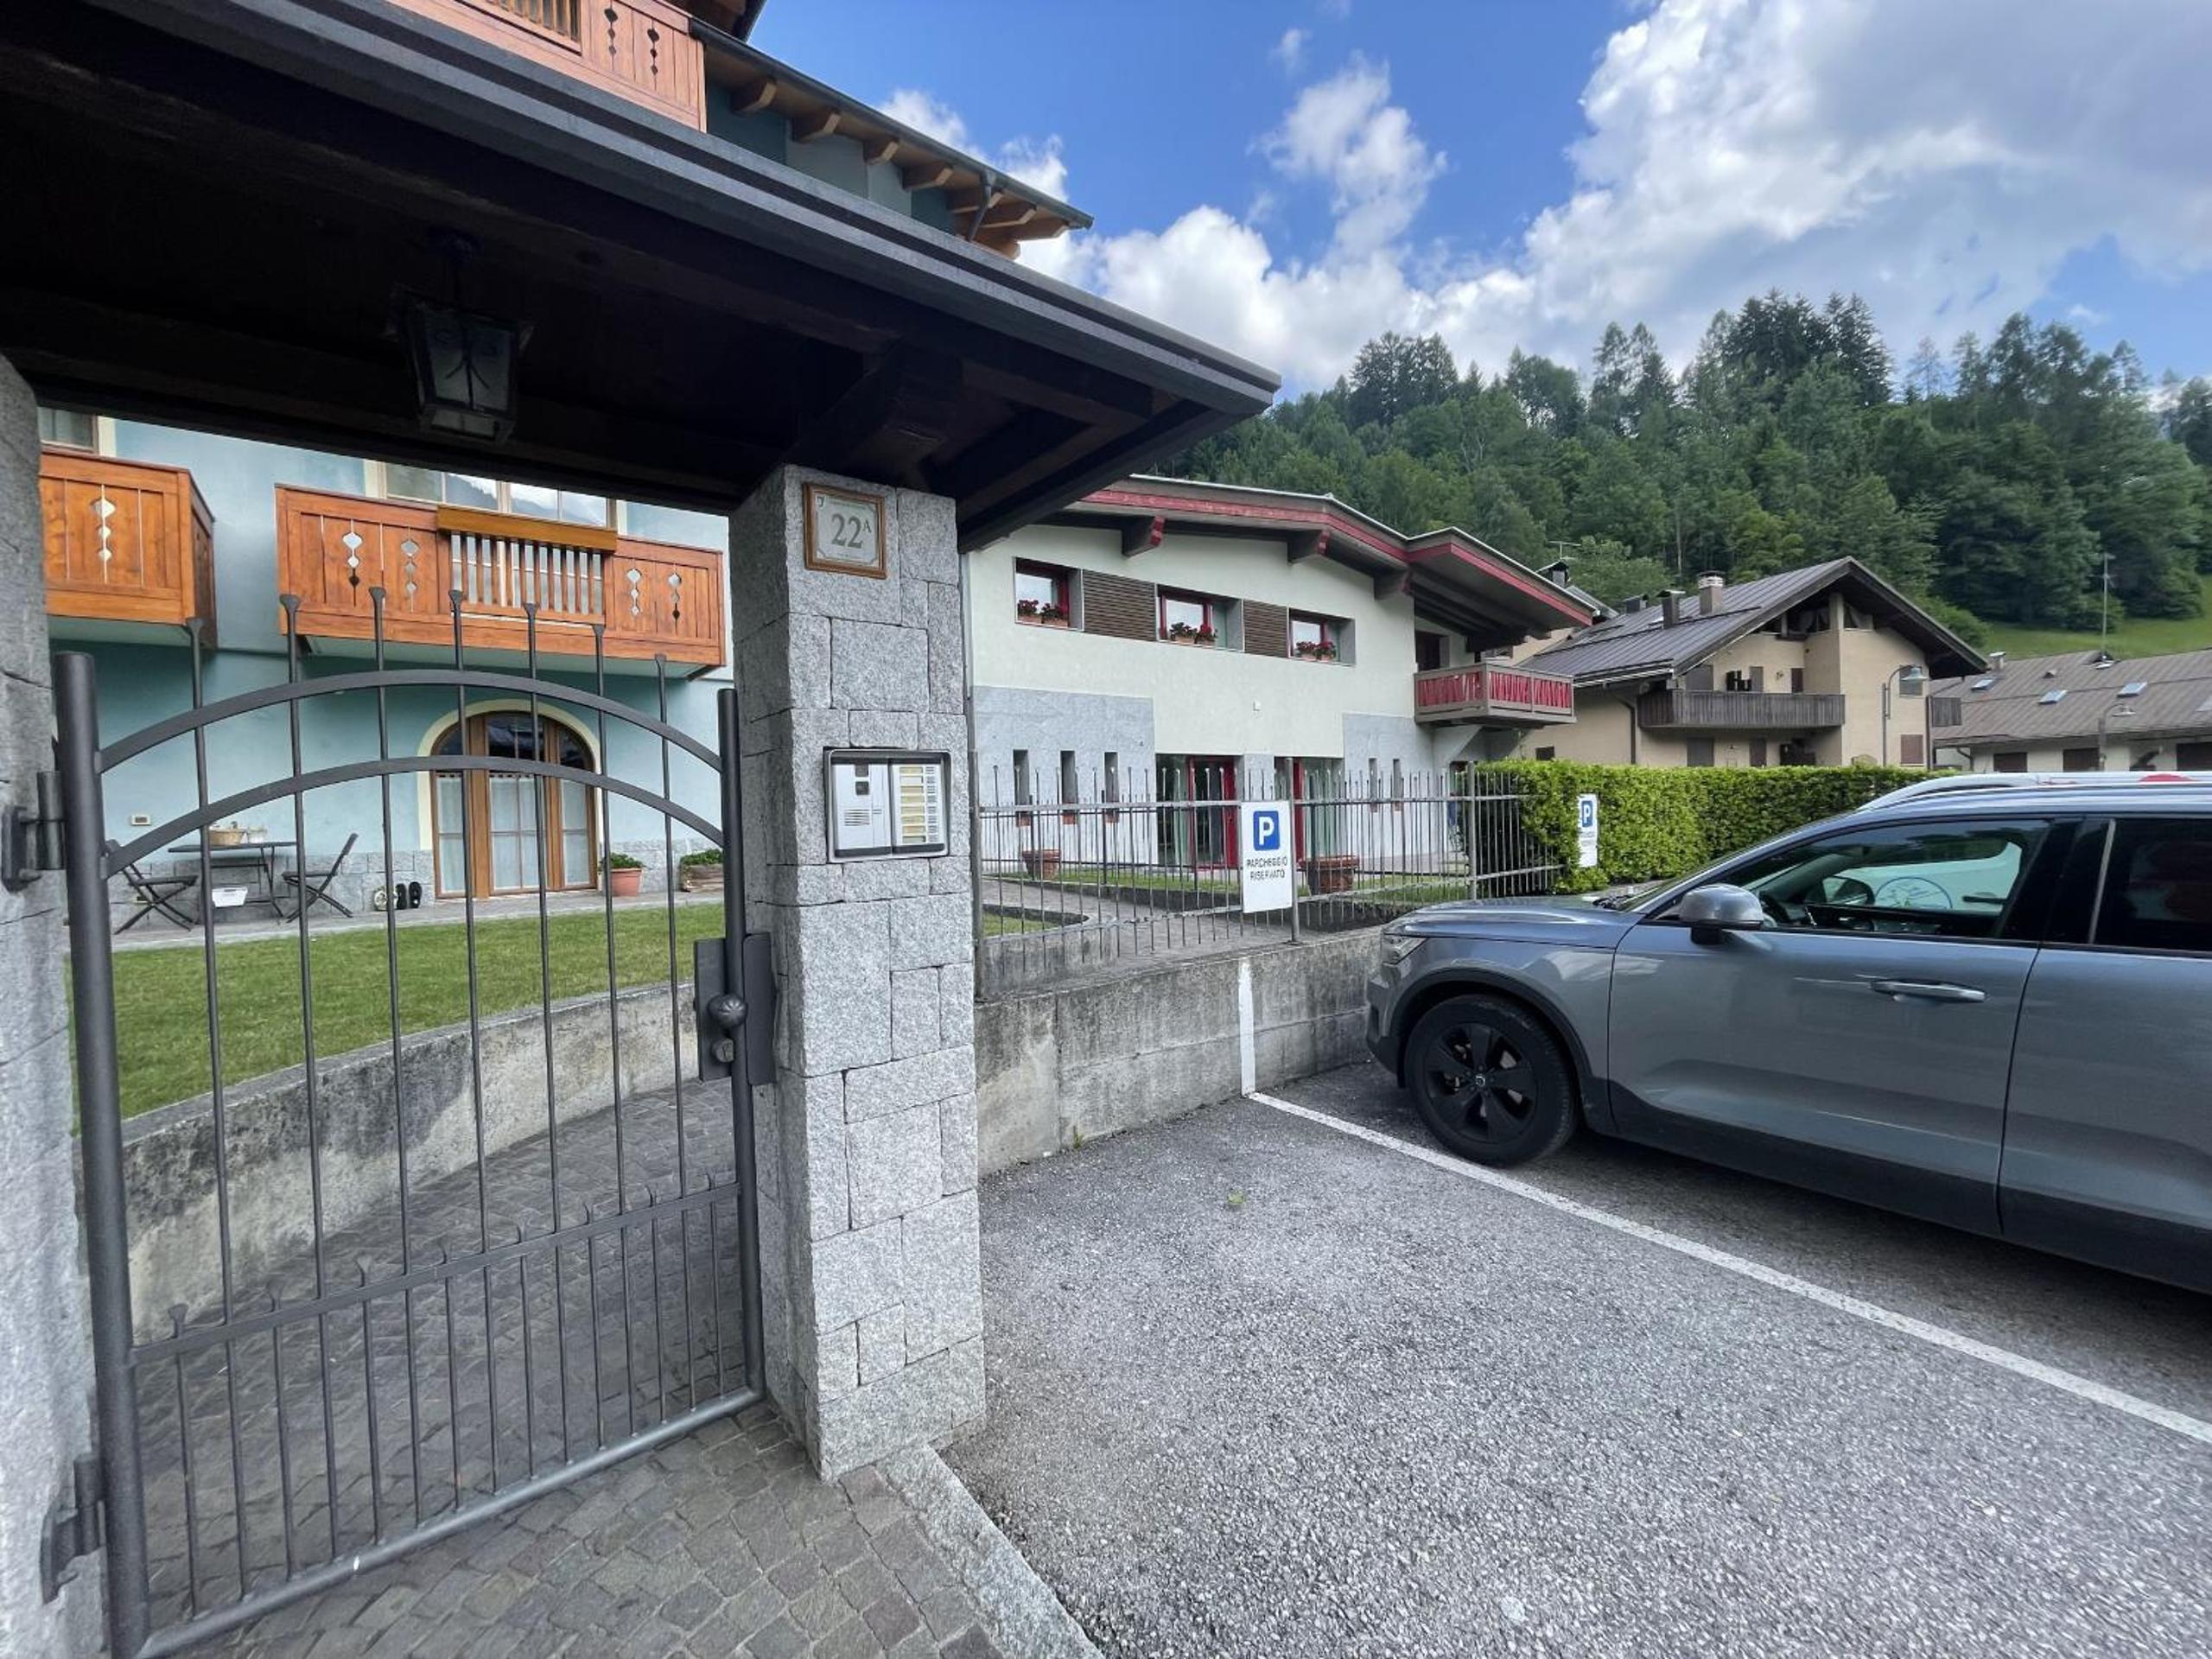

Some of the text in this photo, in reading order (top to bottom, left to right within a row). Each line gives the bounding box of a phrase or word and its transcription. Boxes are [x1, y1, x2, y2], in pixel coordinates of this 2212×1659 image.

[1584, 804, 1591, 823] P
[1259, 817, 1274, 845] P
[1246, 856, 1287, 869] PARCHEGGIO
[1250, 869, 1285, 880] RISERVATO
